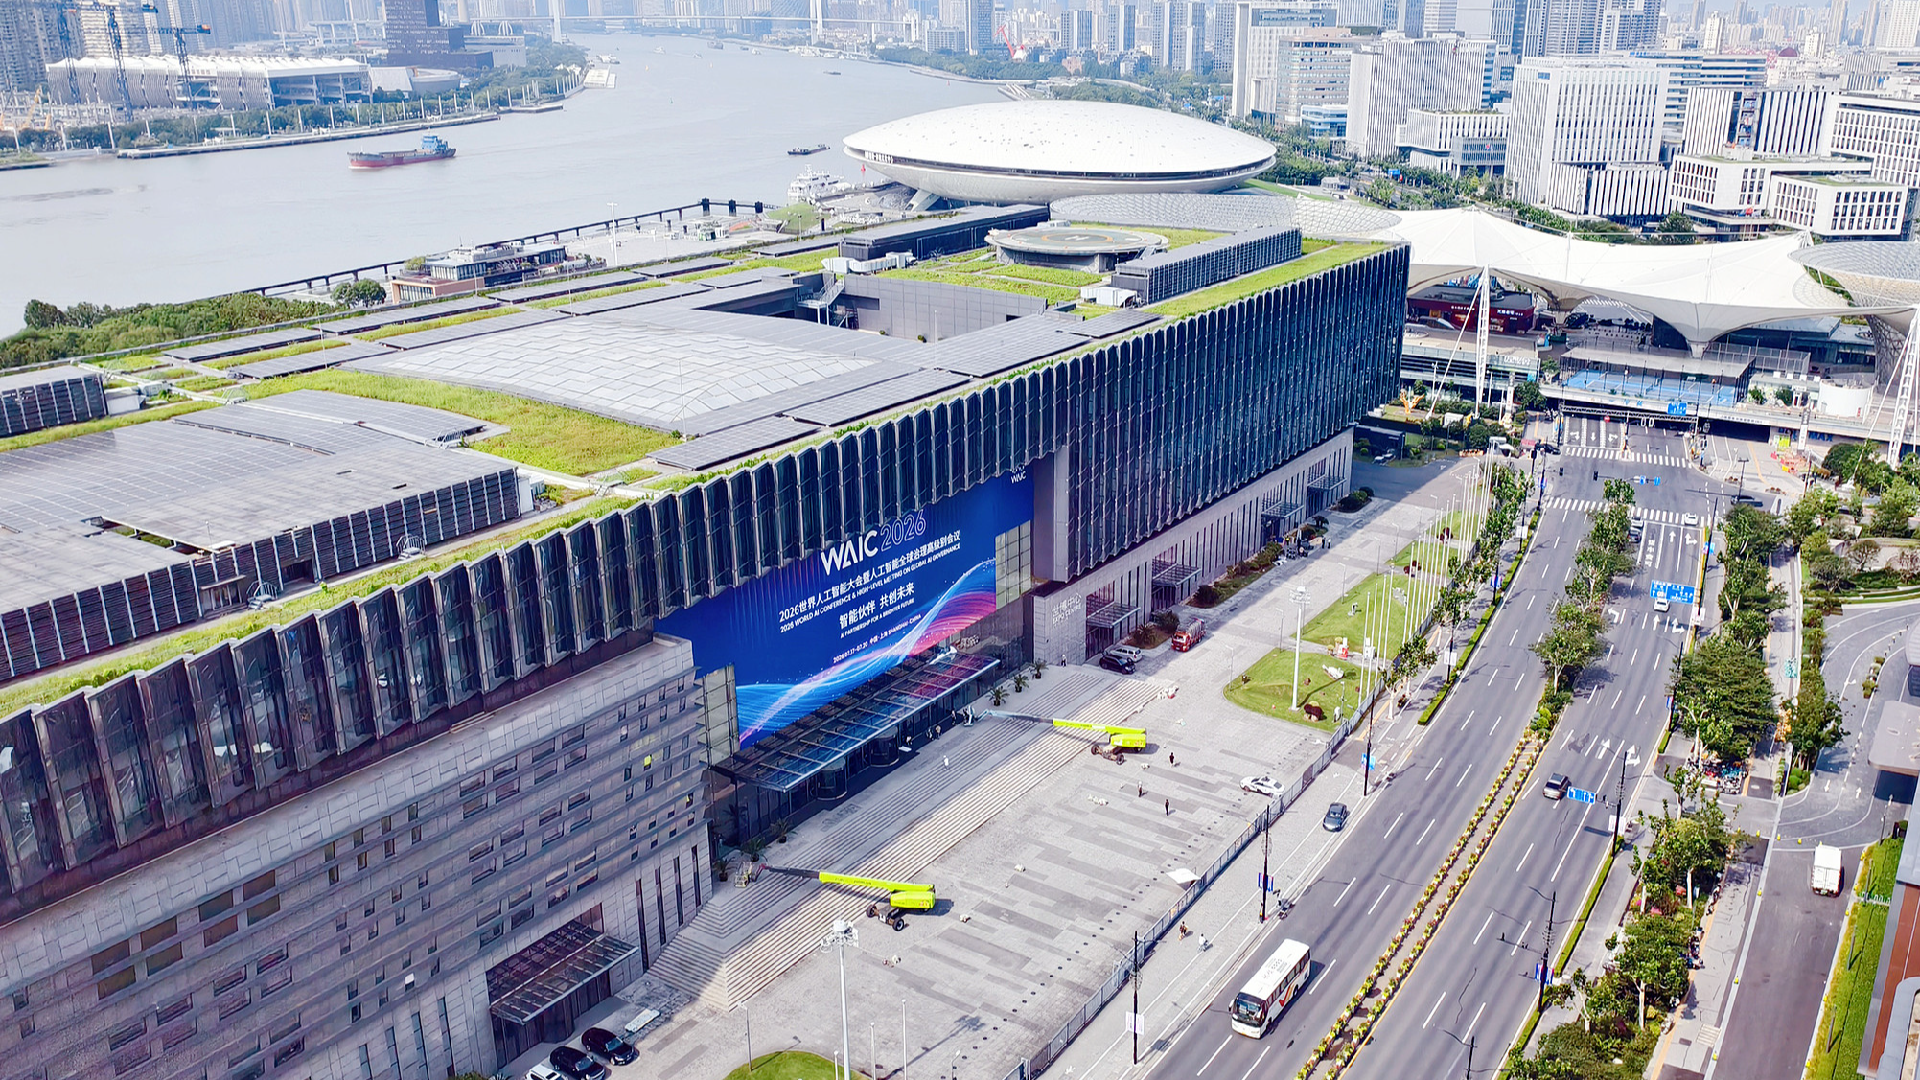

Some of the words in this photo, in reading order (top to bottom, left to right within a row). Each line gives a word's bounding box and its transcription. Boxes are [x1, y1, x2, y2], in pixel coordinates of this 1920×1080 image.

[820, 530, 878, 576] WAIC
[880, 509, 926, 552] 2026
[780, 621, 794, 633] 2026
[795, 612, 813, 627] WORLD
[814, 609, 820, 617] AI
[820, 592, 851, 614] CONFERENCE
[856, 580, 884, 596] HIGH-LEVEL
[903, 565, 911, 574] ON
[911, 560, 926, 571] GLOBAL
[932, 542, 961, 561] GOVERNANCE
[839, 600, 876, 629] 智能伙伴
[879, 582, 915, 610] 共创未来
